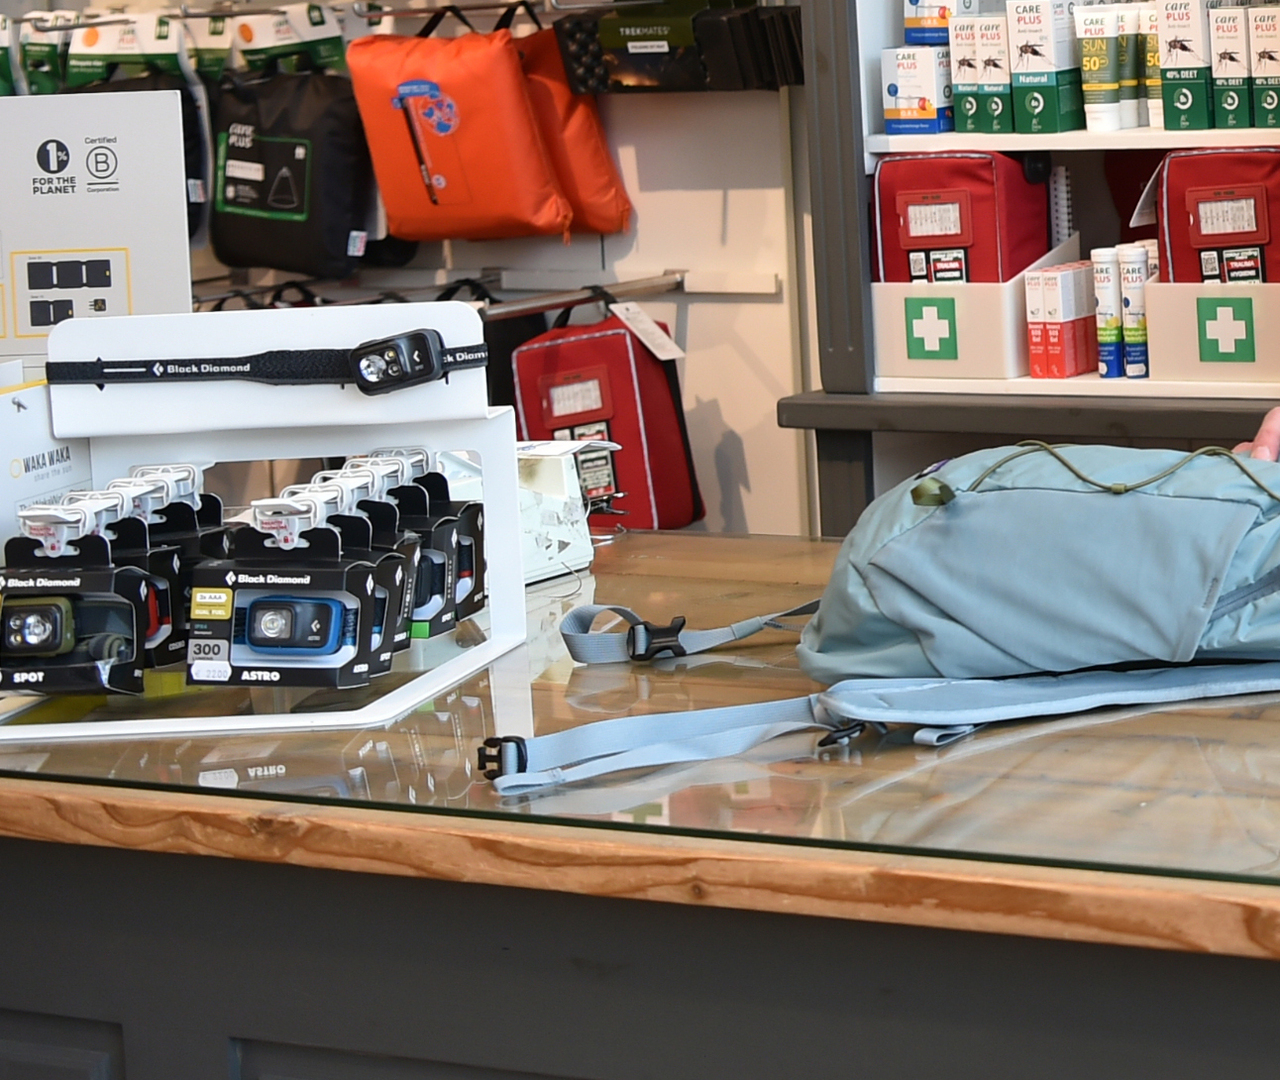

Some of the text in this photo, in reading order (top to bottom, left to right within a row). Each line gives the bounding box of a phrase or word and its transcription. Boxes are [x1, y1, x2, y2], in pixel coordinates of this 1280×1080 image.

[95, 153, 110, 172] B
[32, 176, 76, 185] FOR THE
[33, 185, 76, 195] PLANET
[167, 362, 250, 375] Black Diamond
[23, 445, 71, 474] WAKA WAKA
[7, 577, 81, 588] Black Diamond
[237, 574, 310, 585] Black Diamond
[192, 643, 221, 657] 300
[13, 672, 45, 684] SPOT
[241, 671, 280, 682] ASTRO
